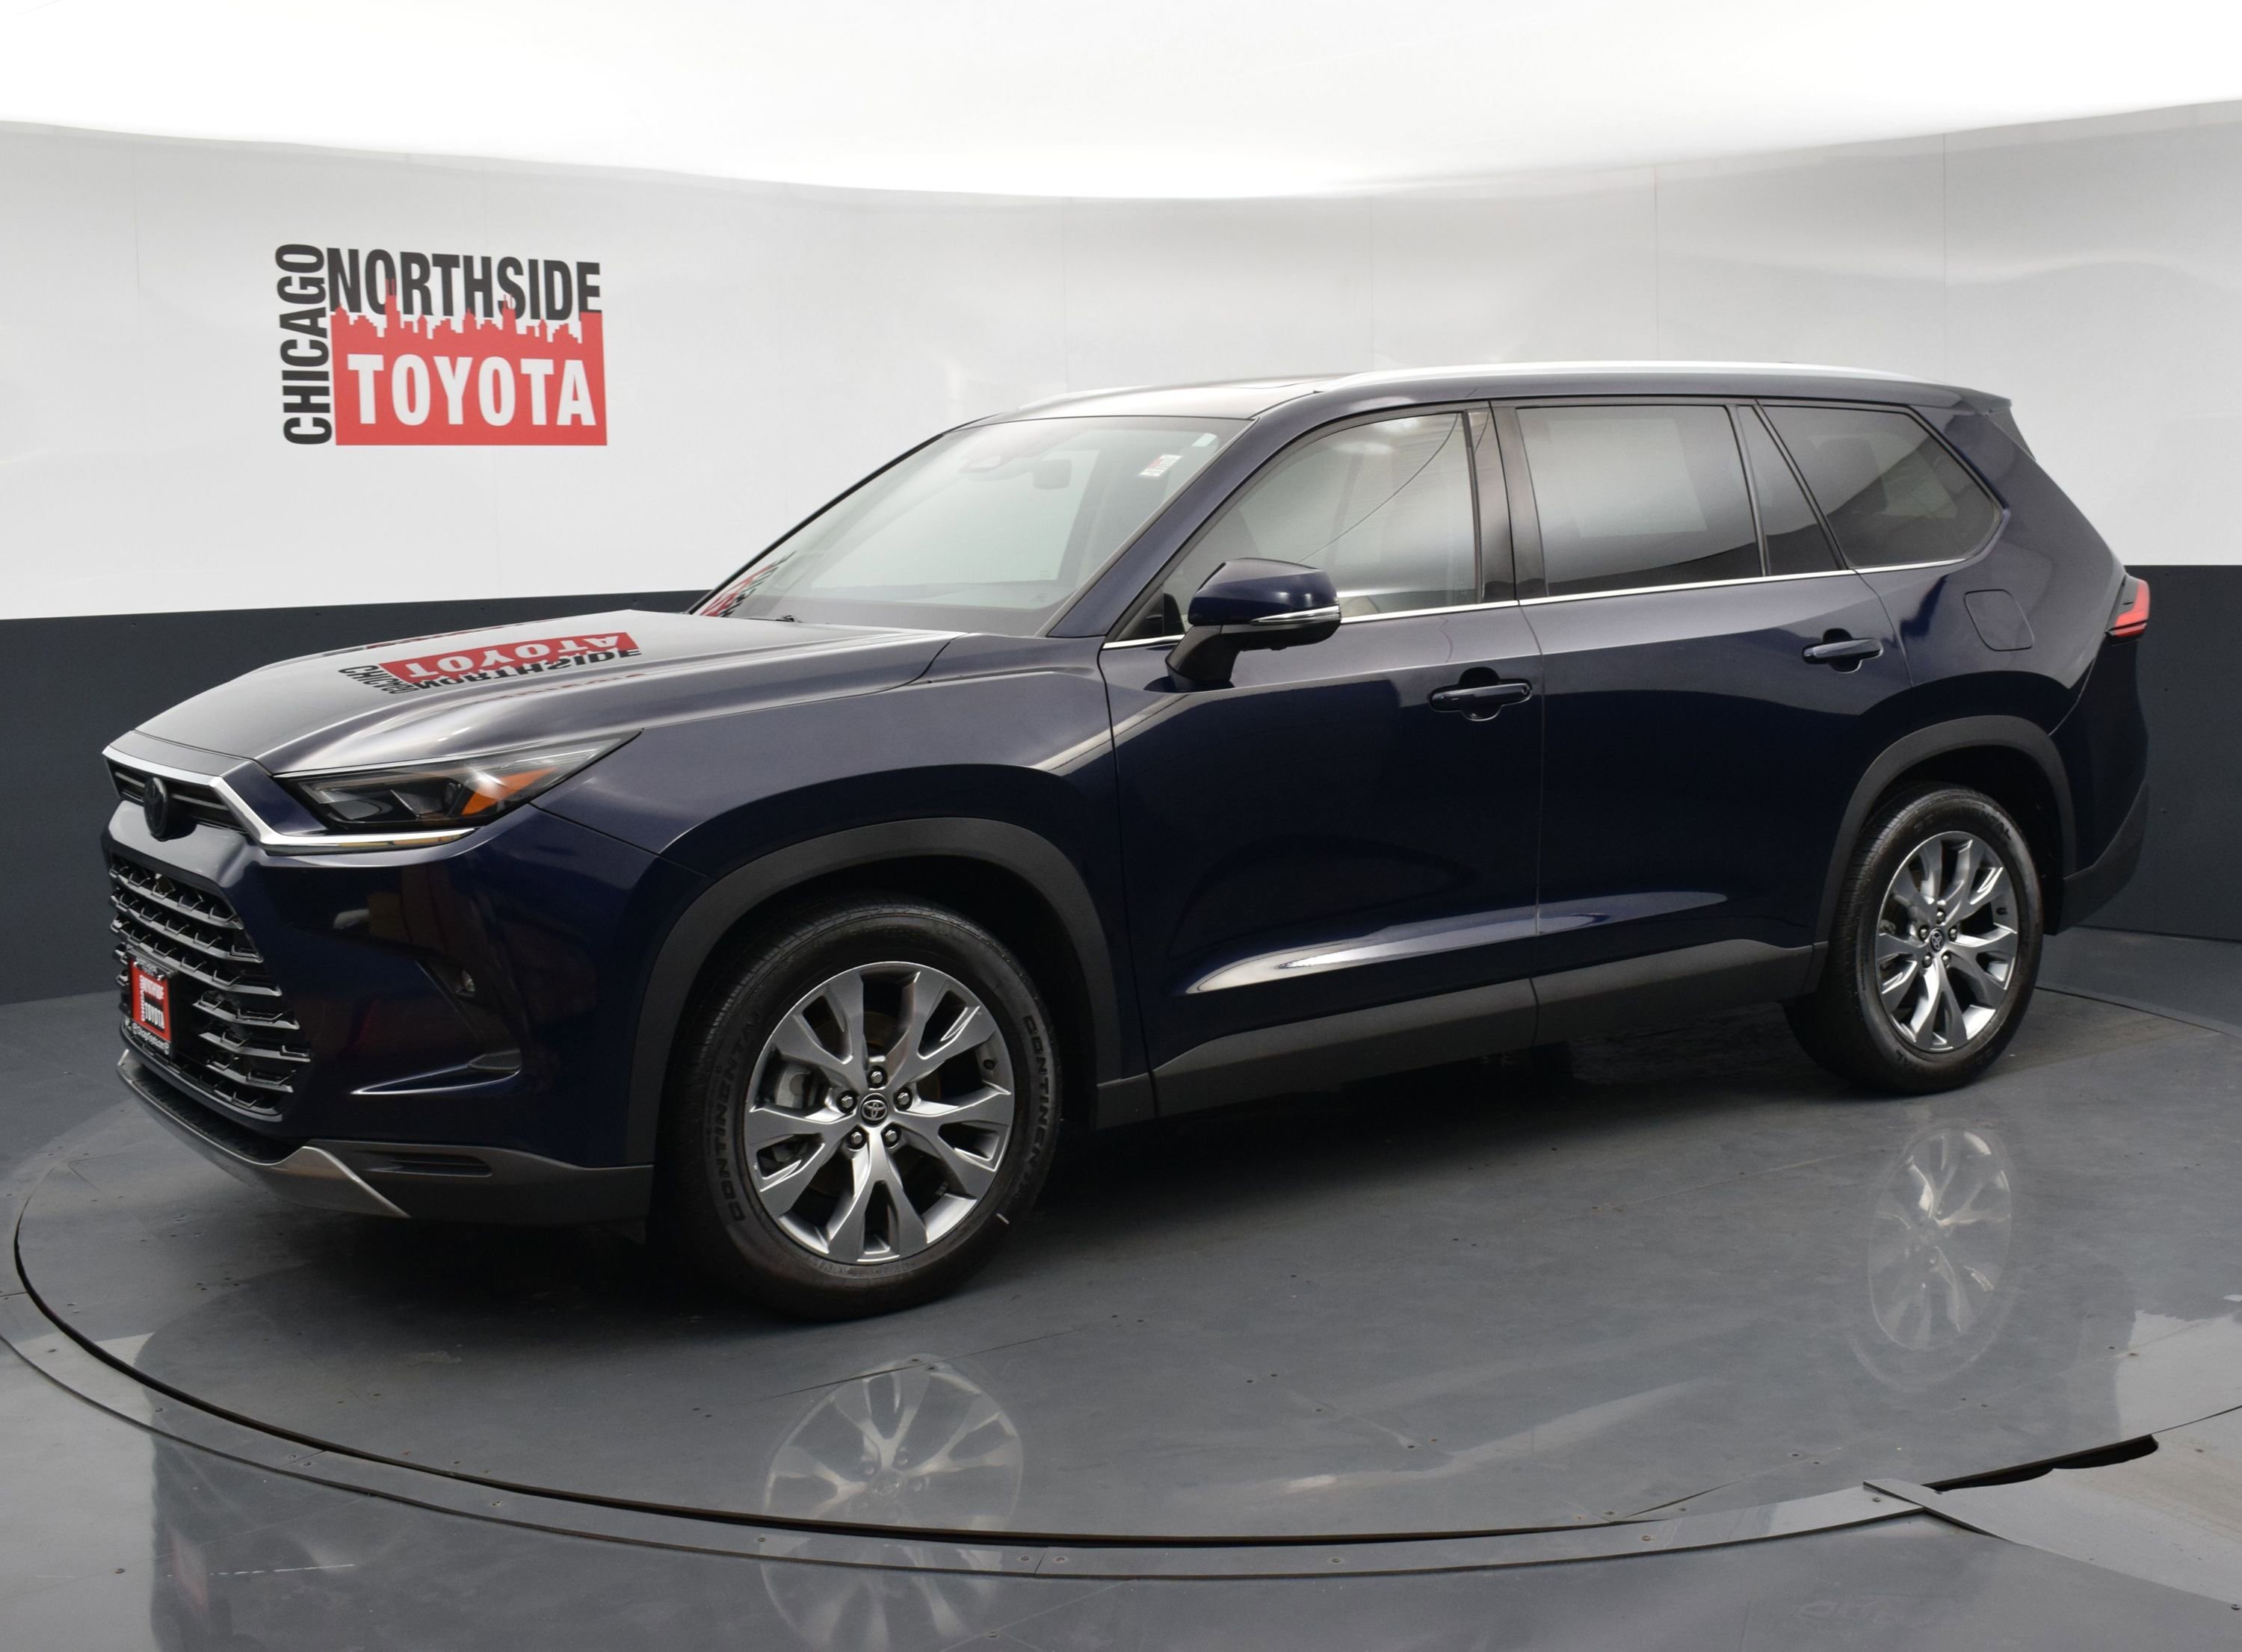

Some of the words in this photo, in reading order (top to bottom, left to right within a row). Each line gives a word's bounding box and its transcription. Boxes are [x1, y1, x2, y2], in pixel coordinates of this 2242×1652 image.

[326, 247, 603, 321] NORTHSIDE
[275, 244, 332, 445] CHICAGO
[347, 353, 596, 427] TOYOTA
